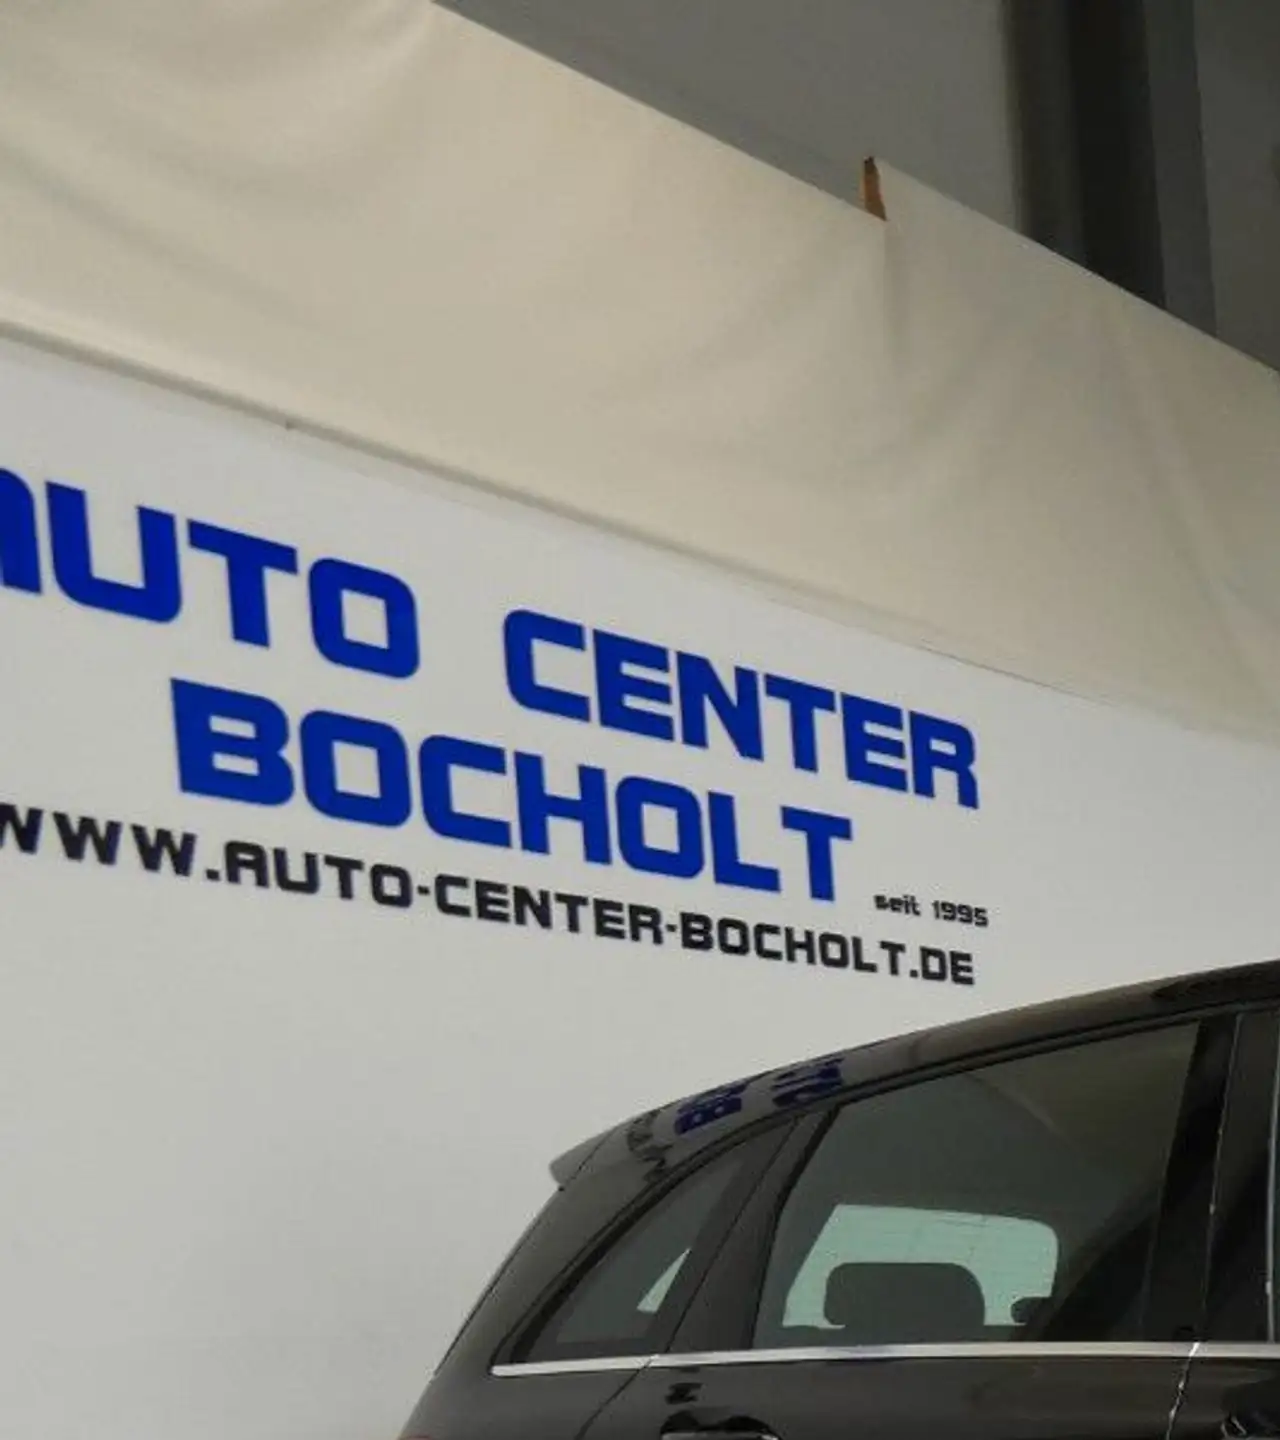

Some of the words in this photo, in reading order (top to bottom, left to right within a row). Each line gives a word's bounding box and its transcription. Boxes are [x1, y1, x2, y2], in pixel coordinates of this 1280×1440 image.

[170, 677, 855, 905] BOCHOLT
[873, 894, 921, 917] seit
[932, 899, 989, 928] 1995
[502, 609, 981, 809] CENTER
